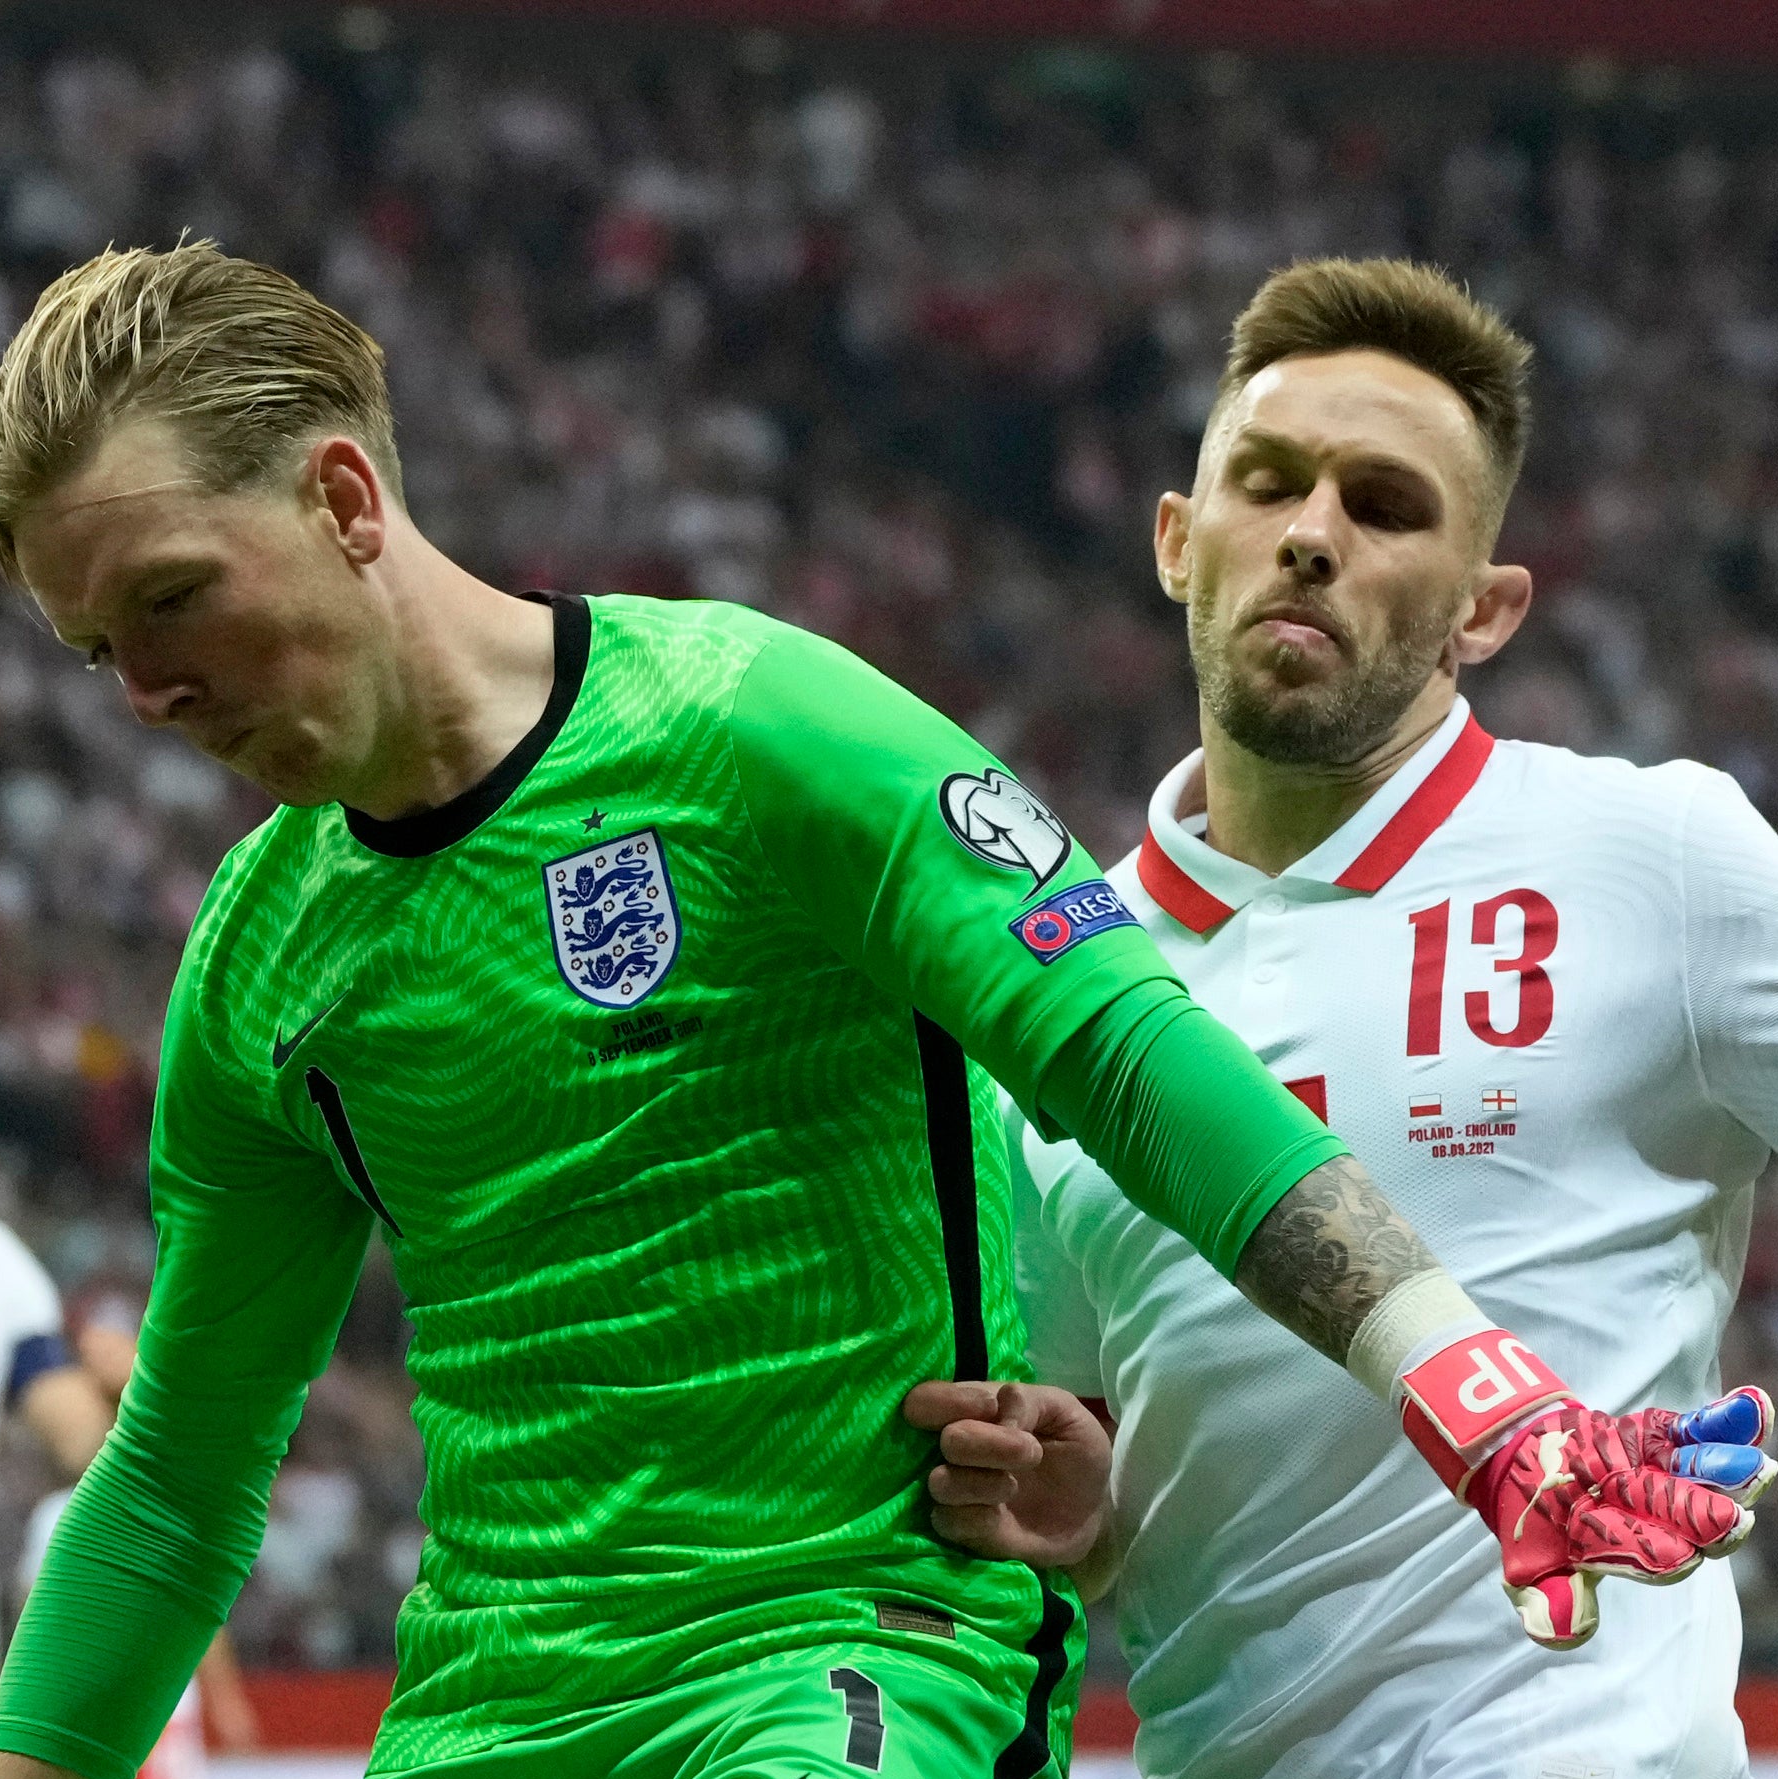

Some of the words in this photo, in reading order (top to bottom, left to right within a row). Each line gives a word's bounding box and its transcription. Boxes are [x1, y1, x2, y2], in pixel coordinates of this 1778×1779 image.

[1407, 888, 1558, 1057] 13
[611, 1011, 664, 1039] POLAND
[598, 1027, 674, 1064] SEPTEMBER
[1408, 1126, 1454, 1143] POLAND
[1465, 1123, 1517, 1137] ENGLAND
[1432, 1142, 1494, 1158] 08.09.2021
[1458, 1338, 1541, 1414] JP
[828, 1667, 886, 1773] 1
